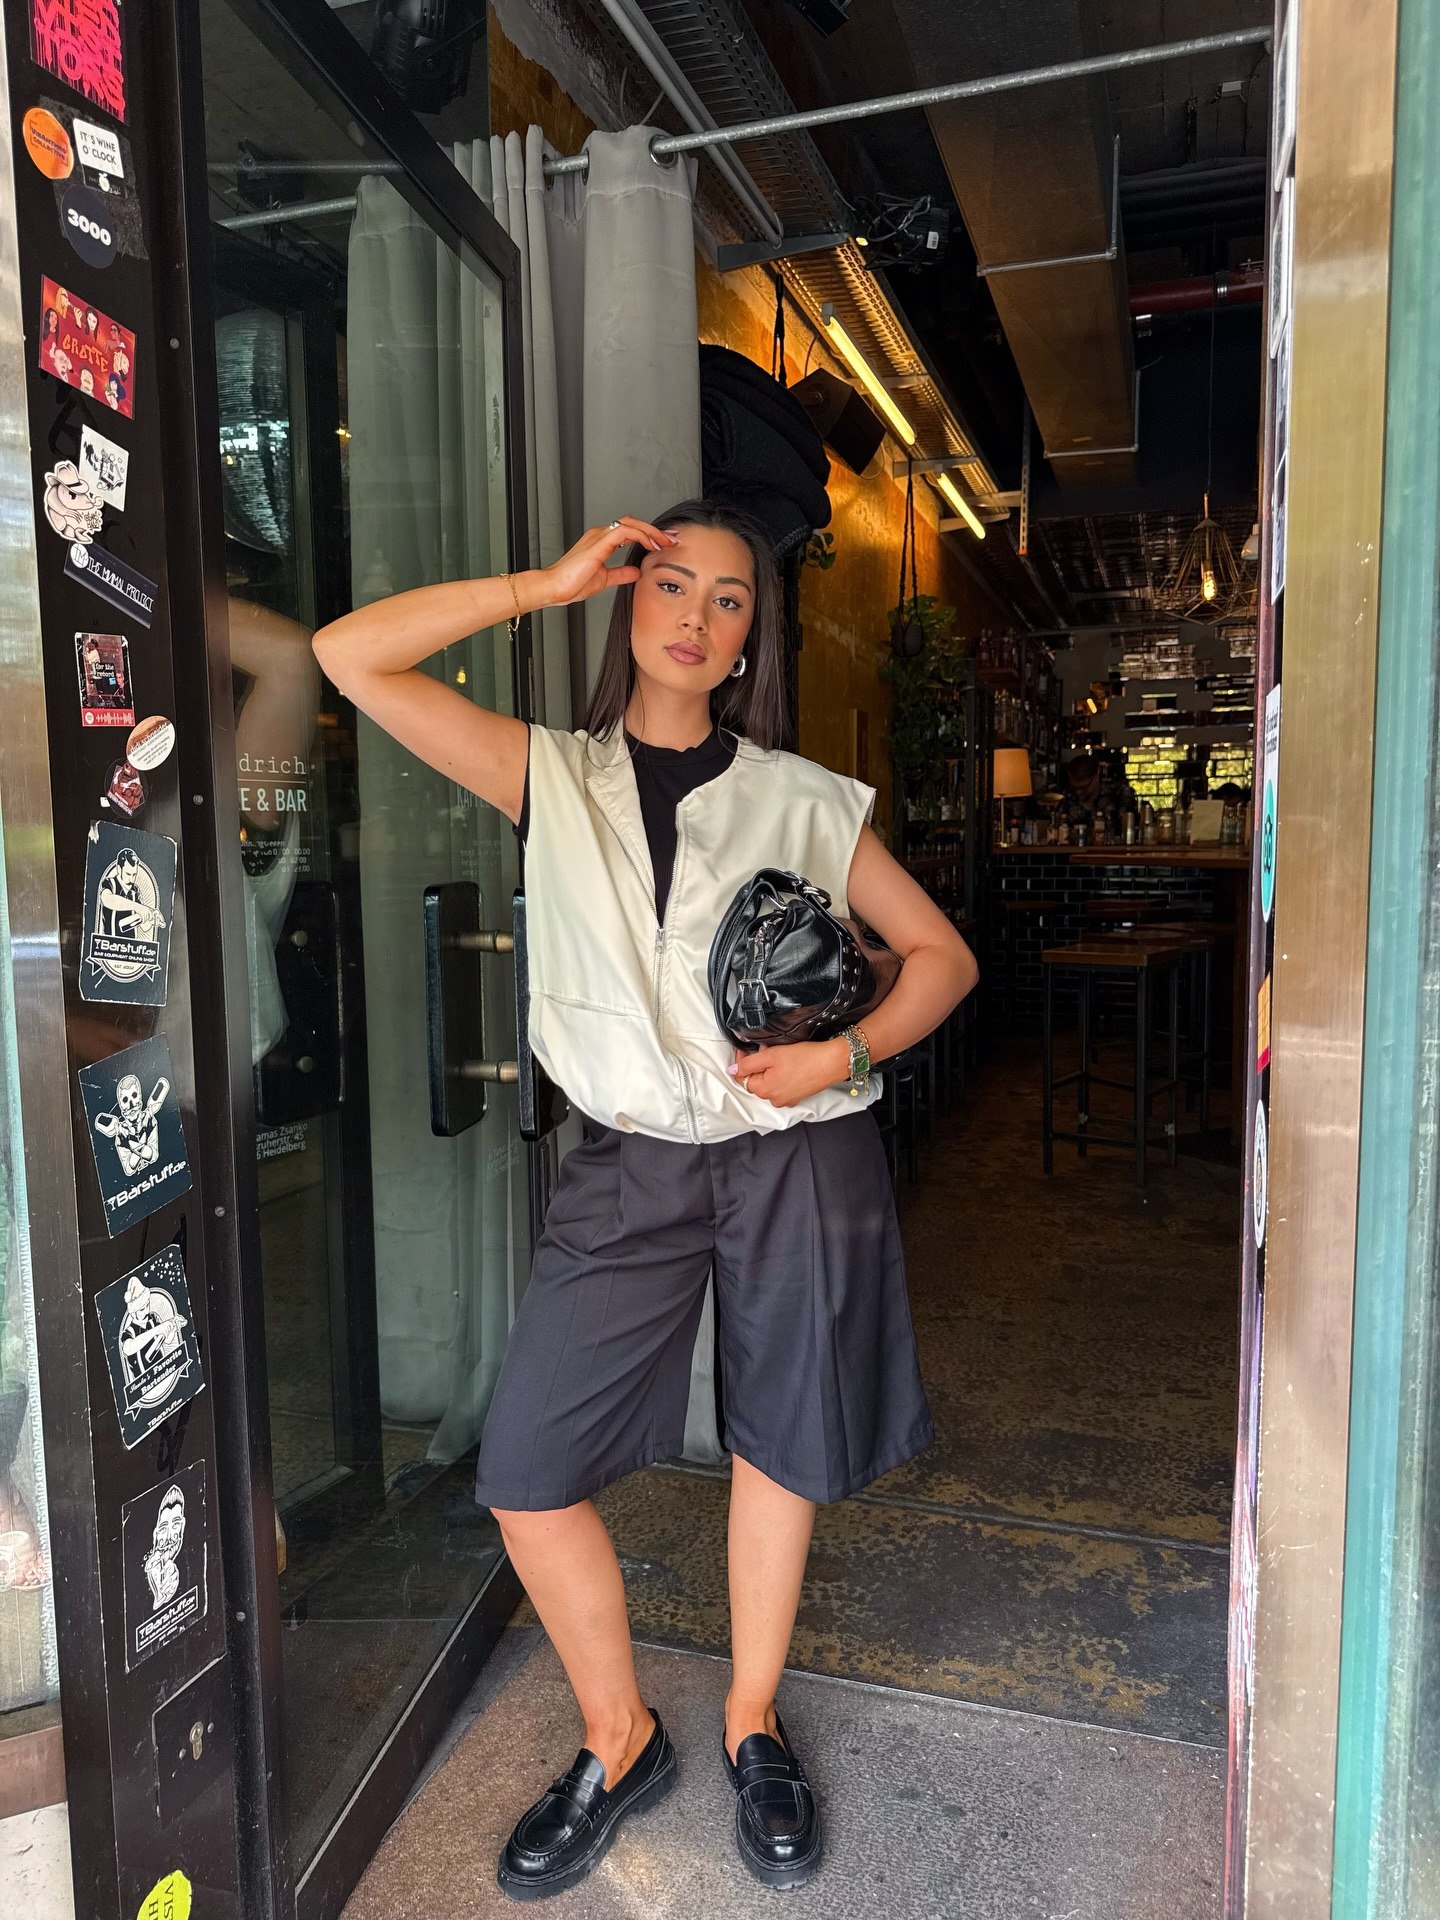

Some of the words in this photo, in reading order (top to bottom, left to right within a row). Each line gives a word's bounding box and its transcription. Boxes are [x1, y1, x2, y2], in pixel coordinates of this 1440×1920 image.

[92, 148, 117, 165] CLOCK
[96, 137, 116, 153] WINE
[67, 208, 112, 246] 3000
[87, 556, 103, 577] THE
[95, 662, 105, 671] for
[105, 663, 114, 671] the
[239, 753, 306, 775] drich
[257, 788, 270, 811] &
[275, 788, 307, 812] BAR
[101, 940, 156, 956] Barstuff.de
[263, 1141, 306, 1158] Heidelberg
[116, 1161, 187, 1207] Barstuff.de
[153, 1349, 182, 1375] Favorite
[141, 1364, 176, 1395] Bartender
[146, 1596, 195, 1636] Barstuff.de
[164, 1880, 174, 1920] VIS
